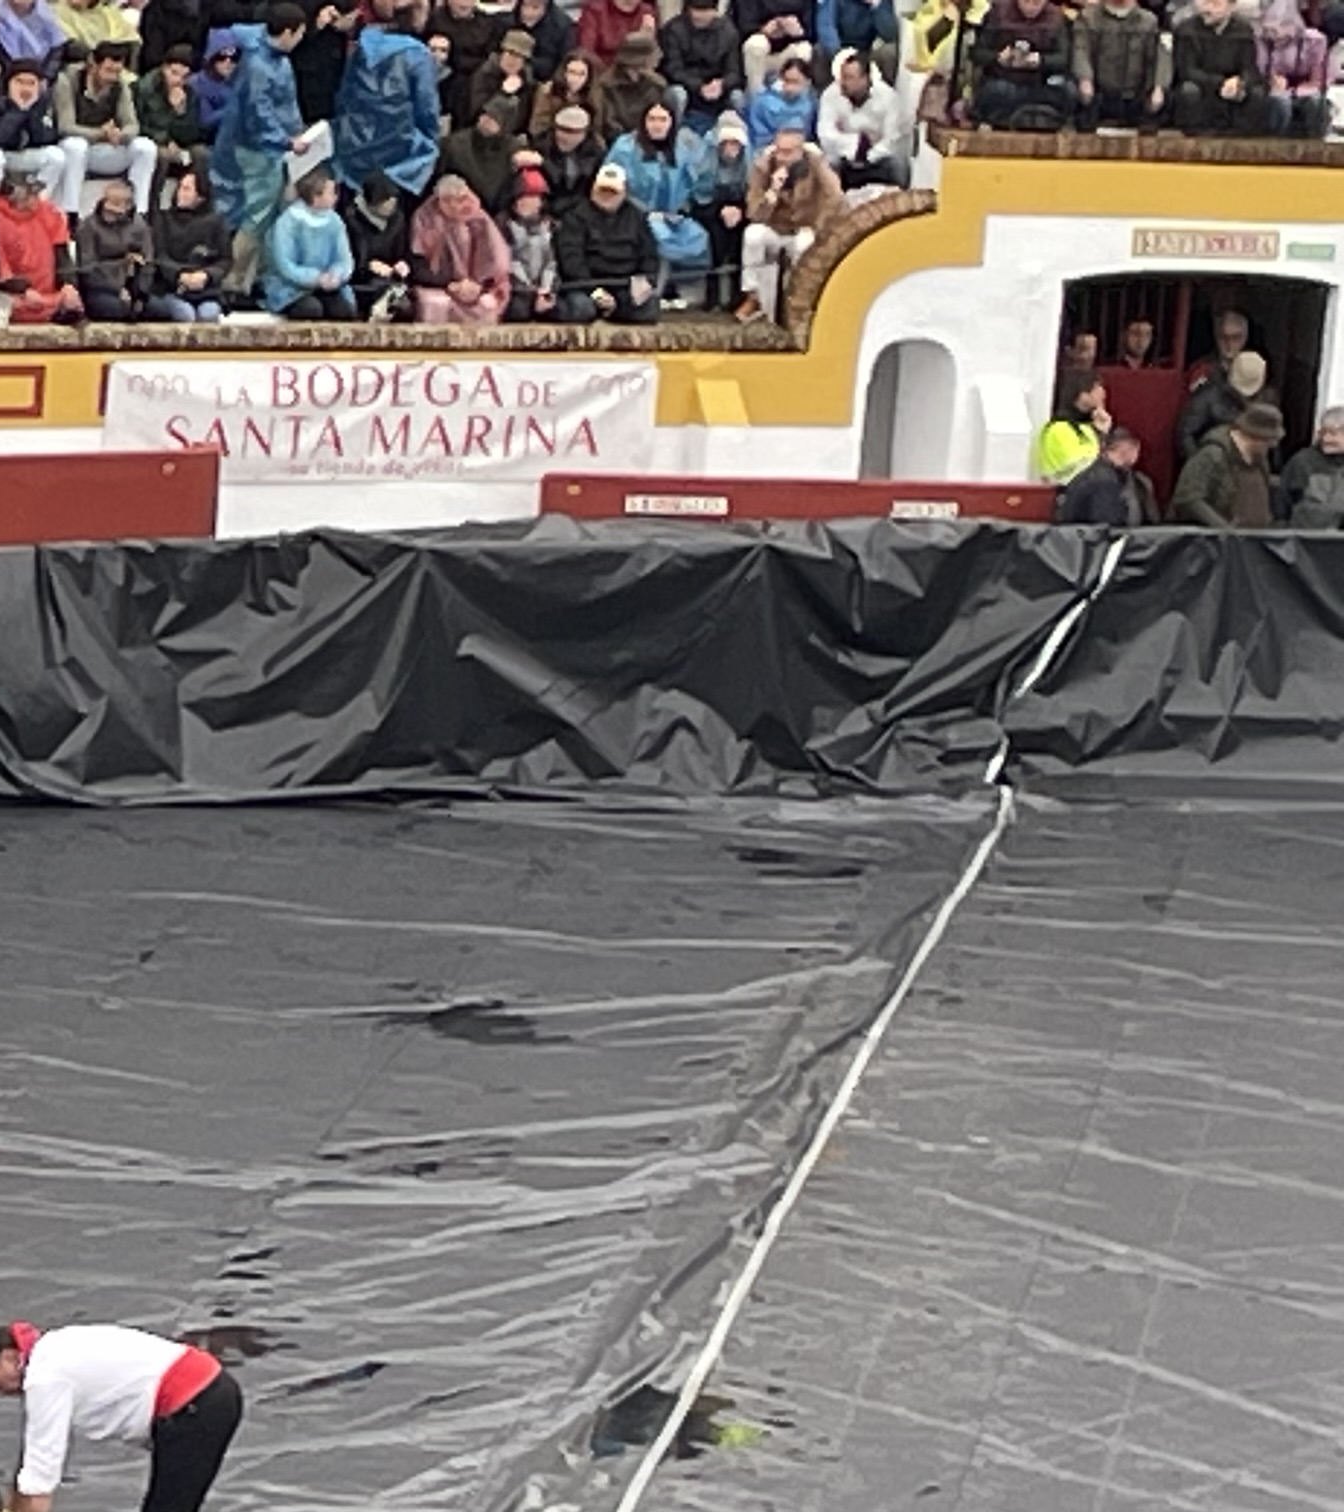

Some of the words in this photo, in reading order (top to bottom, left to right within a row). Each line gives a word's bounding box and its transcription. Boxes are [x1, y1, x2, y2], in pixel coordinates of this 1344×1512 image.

[215, 386, 253, 410] LA
[272, 364, 503, 408] BODEGA
[517, 380, 558, 407] DE
[165, 414, 344, 459] SANTA
[369, 413, 599, 458] MARINA
